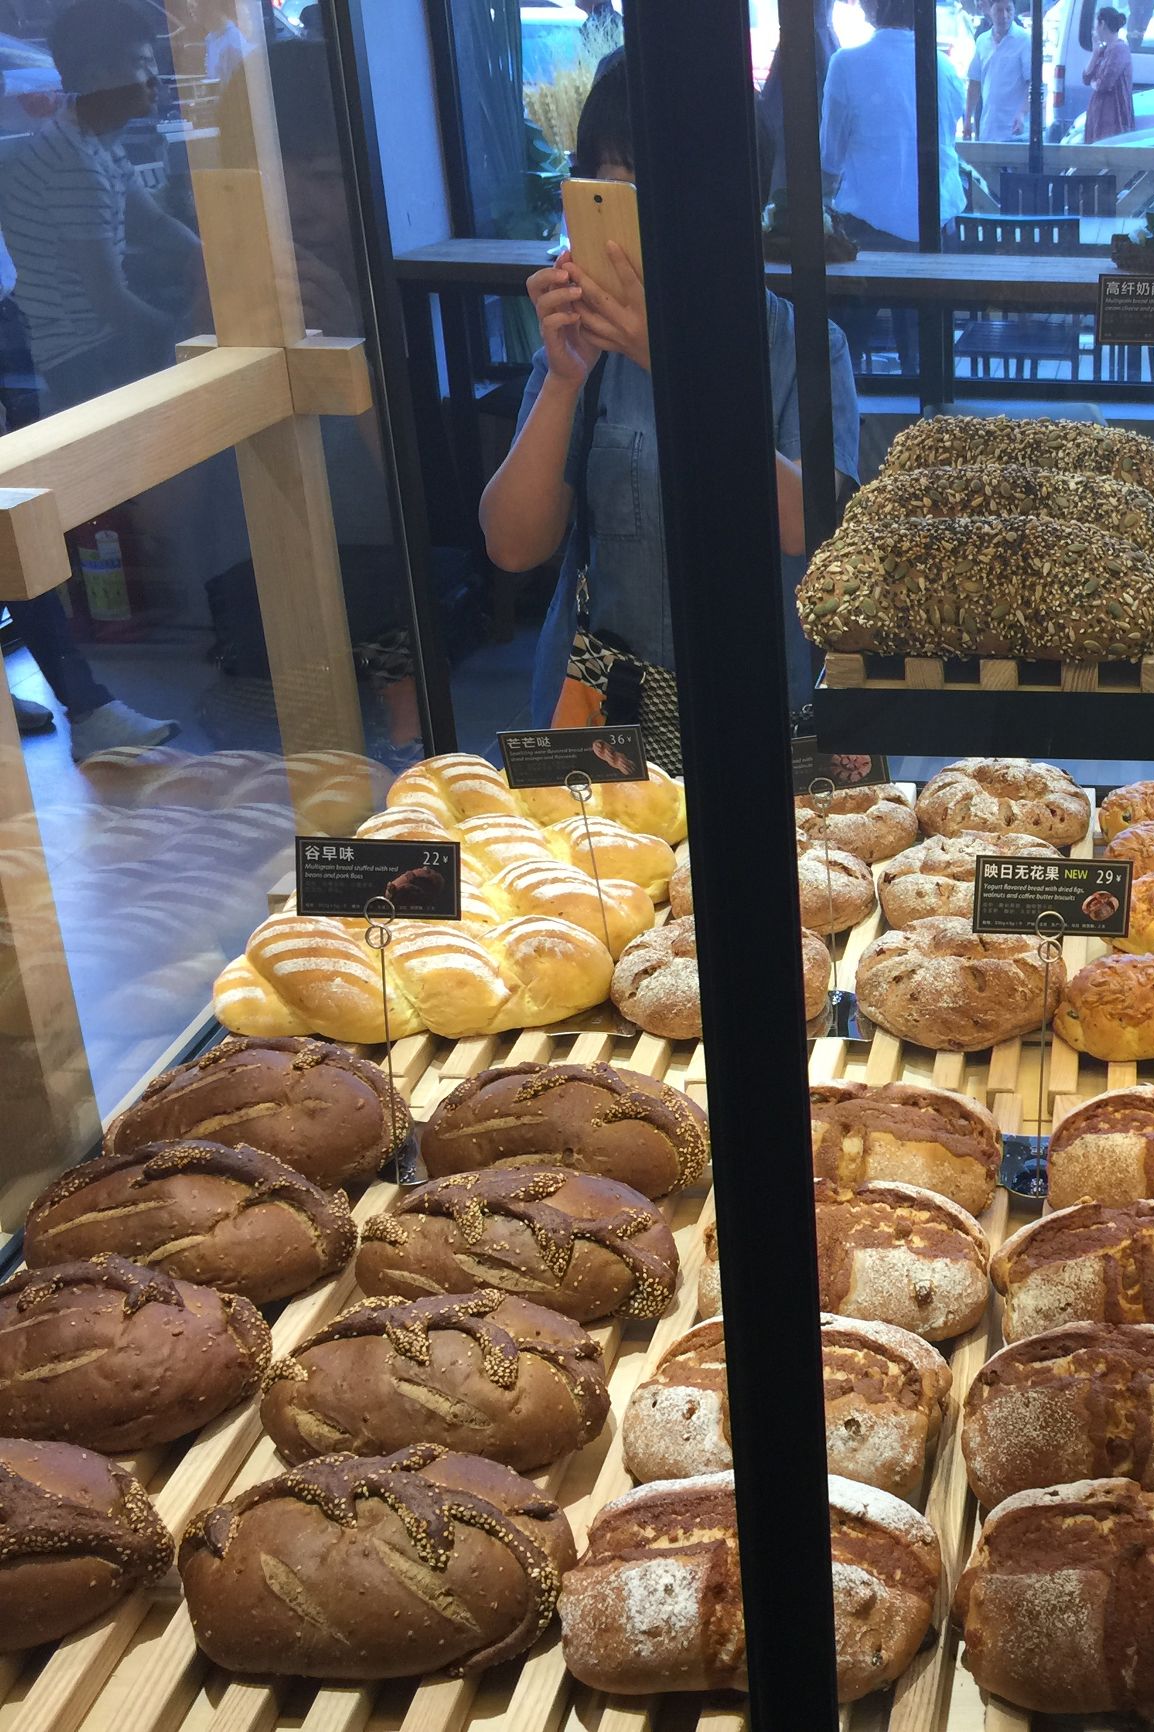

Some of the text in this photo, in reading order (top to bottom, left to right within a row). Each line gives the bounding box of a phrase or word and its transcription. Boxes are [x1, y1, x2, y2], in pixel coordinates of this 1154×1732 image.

[506, 736, 552, 750] 芒芒哒
[304, 845, 355, 862] 谷早味
[304, 863, 336, 872] Multigrain
[984, 863, 1060, 881] 映日无花果
[335, 872, 350, 880] pork
[1064, 869, 1088, 880] NEW
[983, 883, 1003, 891] Yogurt
[1003, 883, 1027, 891] flavored
[983, 891, 1006, 899] walnuts
